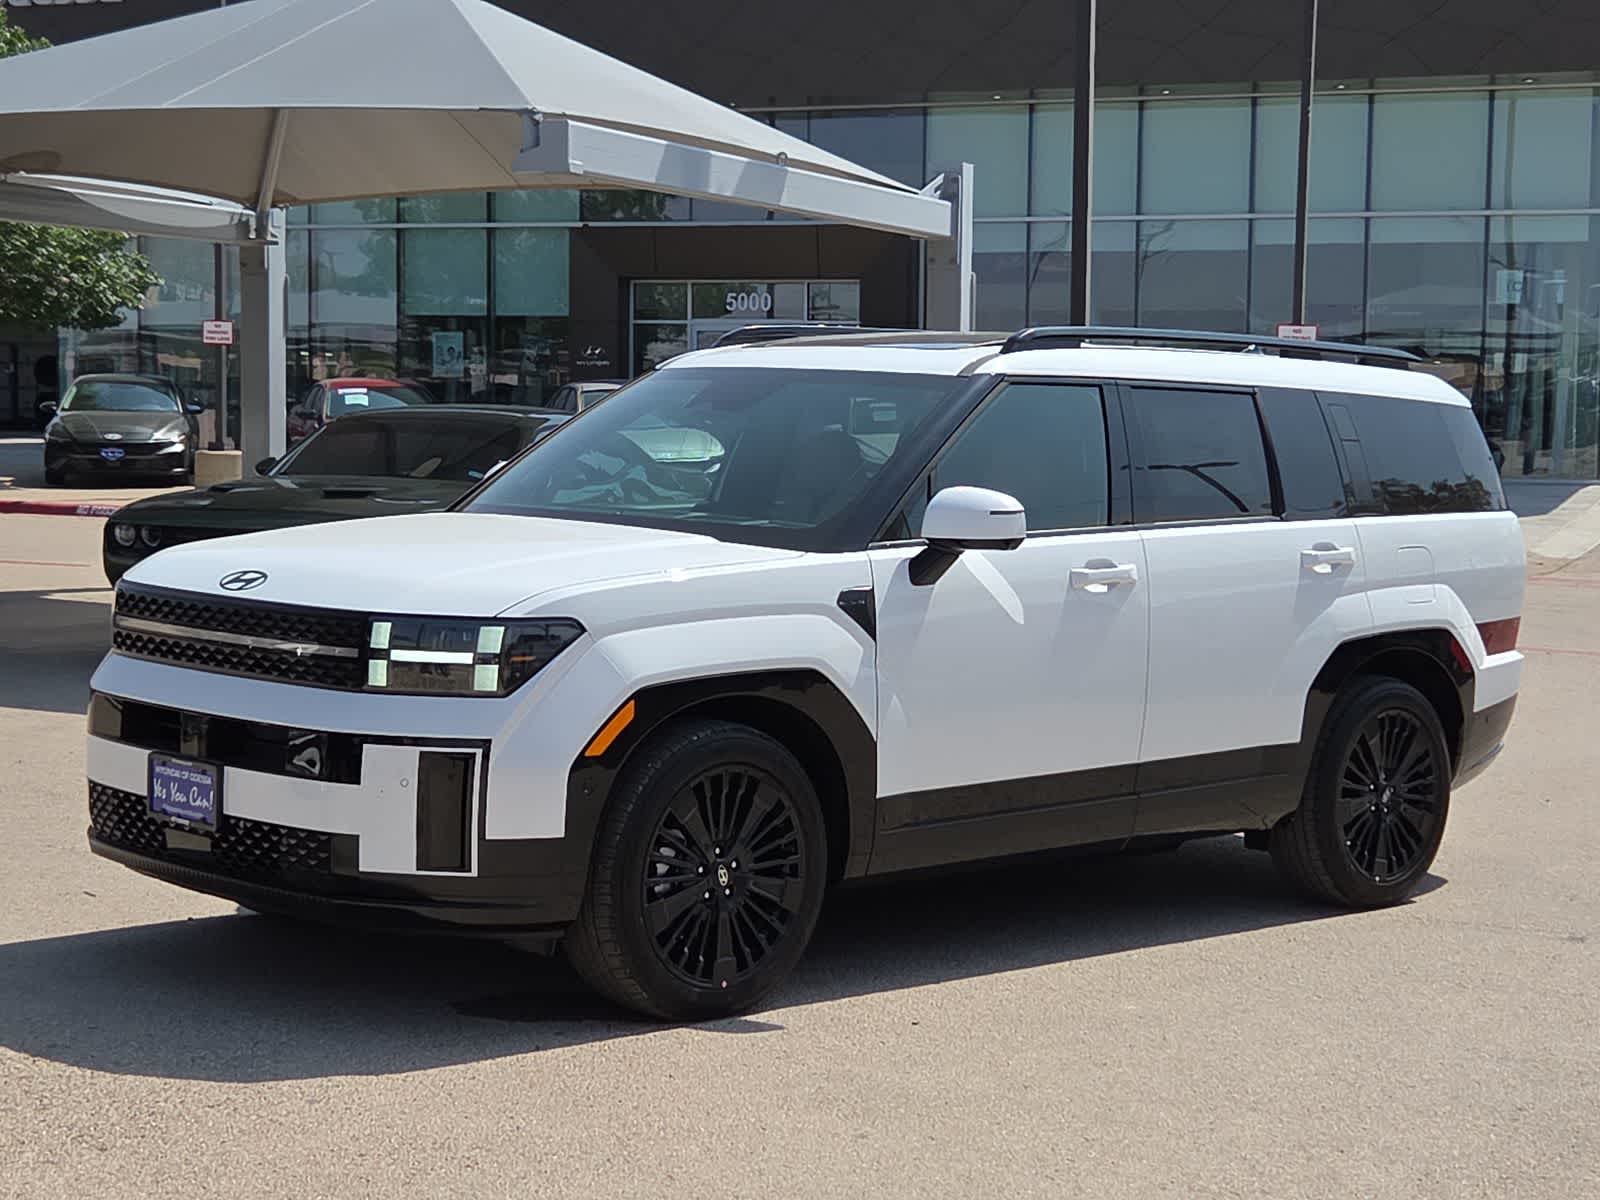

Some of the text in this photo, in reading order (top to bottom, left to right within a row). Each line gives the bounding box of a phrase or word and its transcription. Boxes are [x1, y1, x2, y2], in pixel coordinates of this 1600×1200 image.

[726, 292, 771, 311] 5000
[153, 778, 166, 799] Yes
[170, 781, 187, 802] You
[190, 786, 214, 811] Can!
